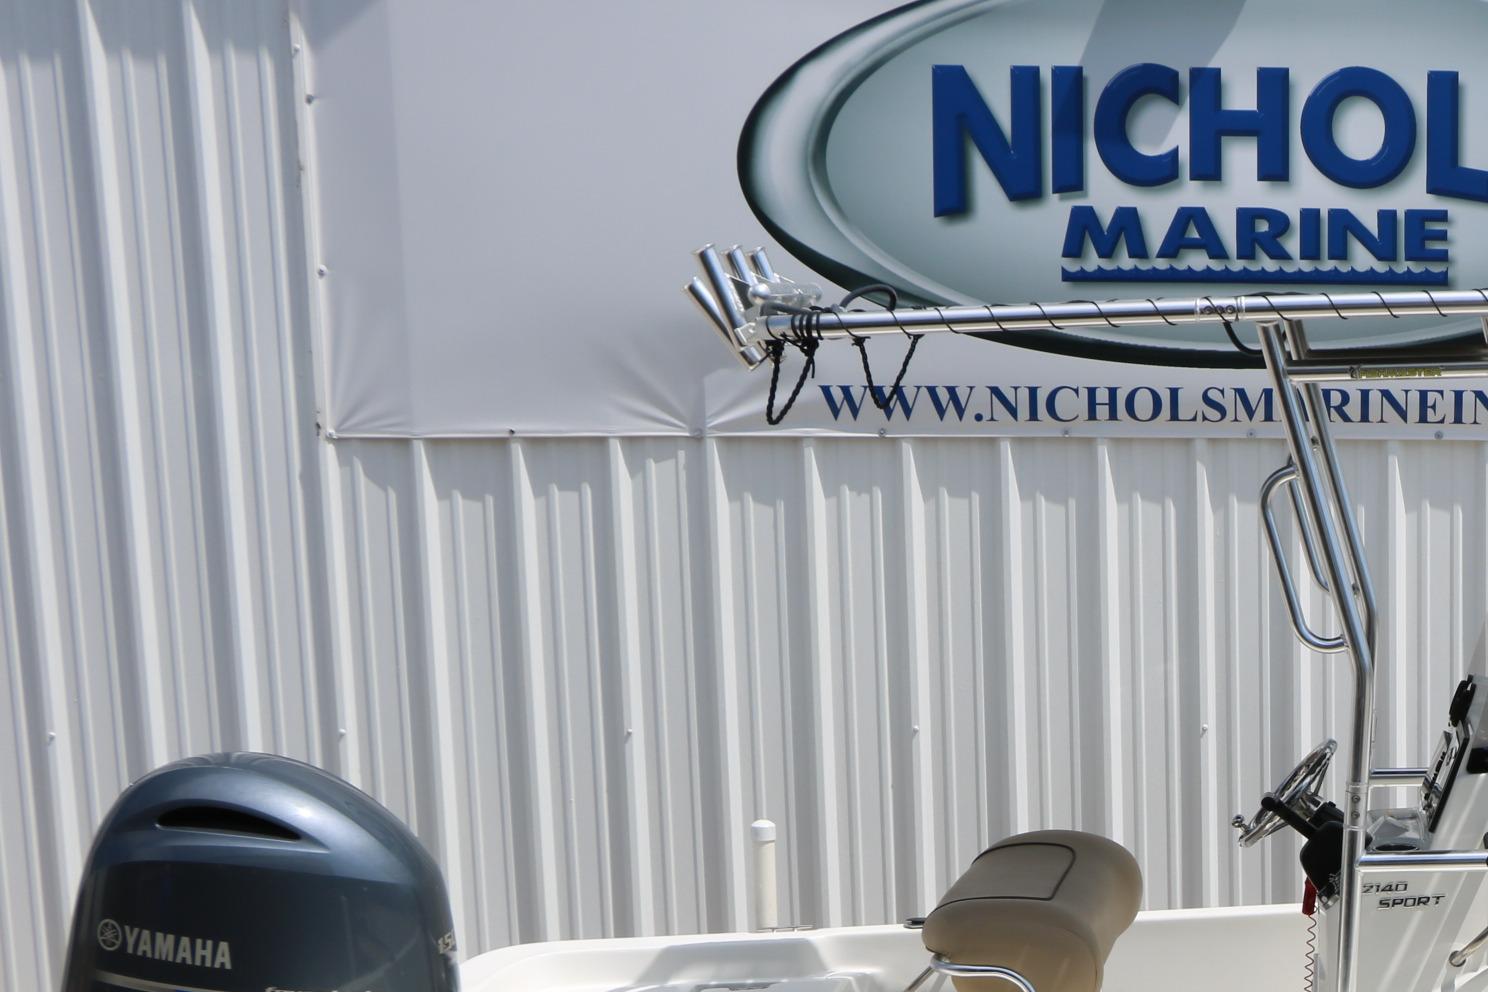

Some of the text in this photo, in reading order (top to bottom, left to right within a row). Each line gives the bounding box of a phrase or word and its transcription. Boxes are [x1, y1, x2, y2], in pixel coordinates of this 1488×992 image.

[1061, 205, 1450, 262] MARINE
[1361, 881, 1408, 894] 2140
[1377, 894, 1446, 910] SPORT
[123, 924, 232, 970] YAMAHA
